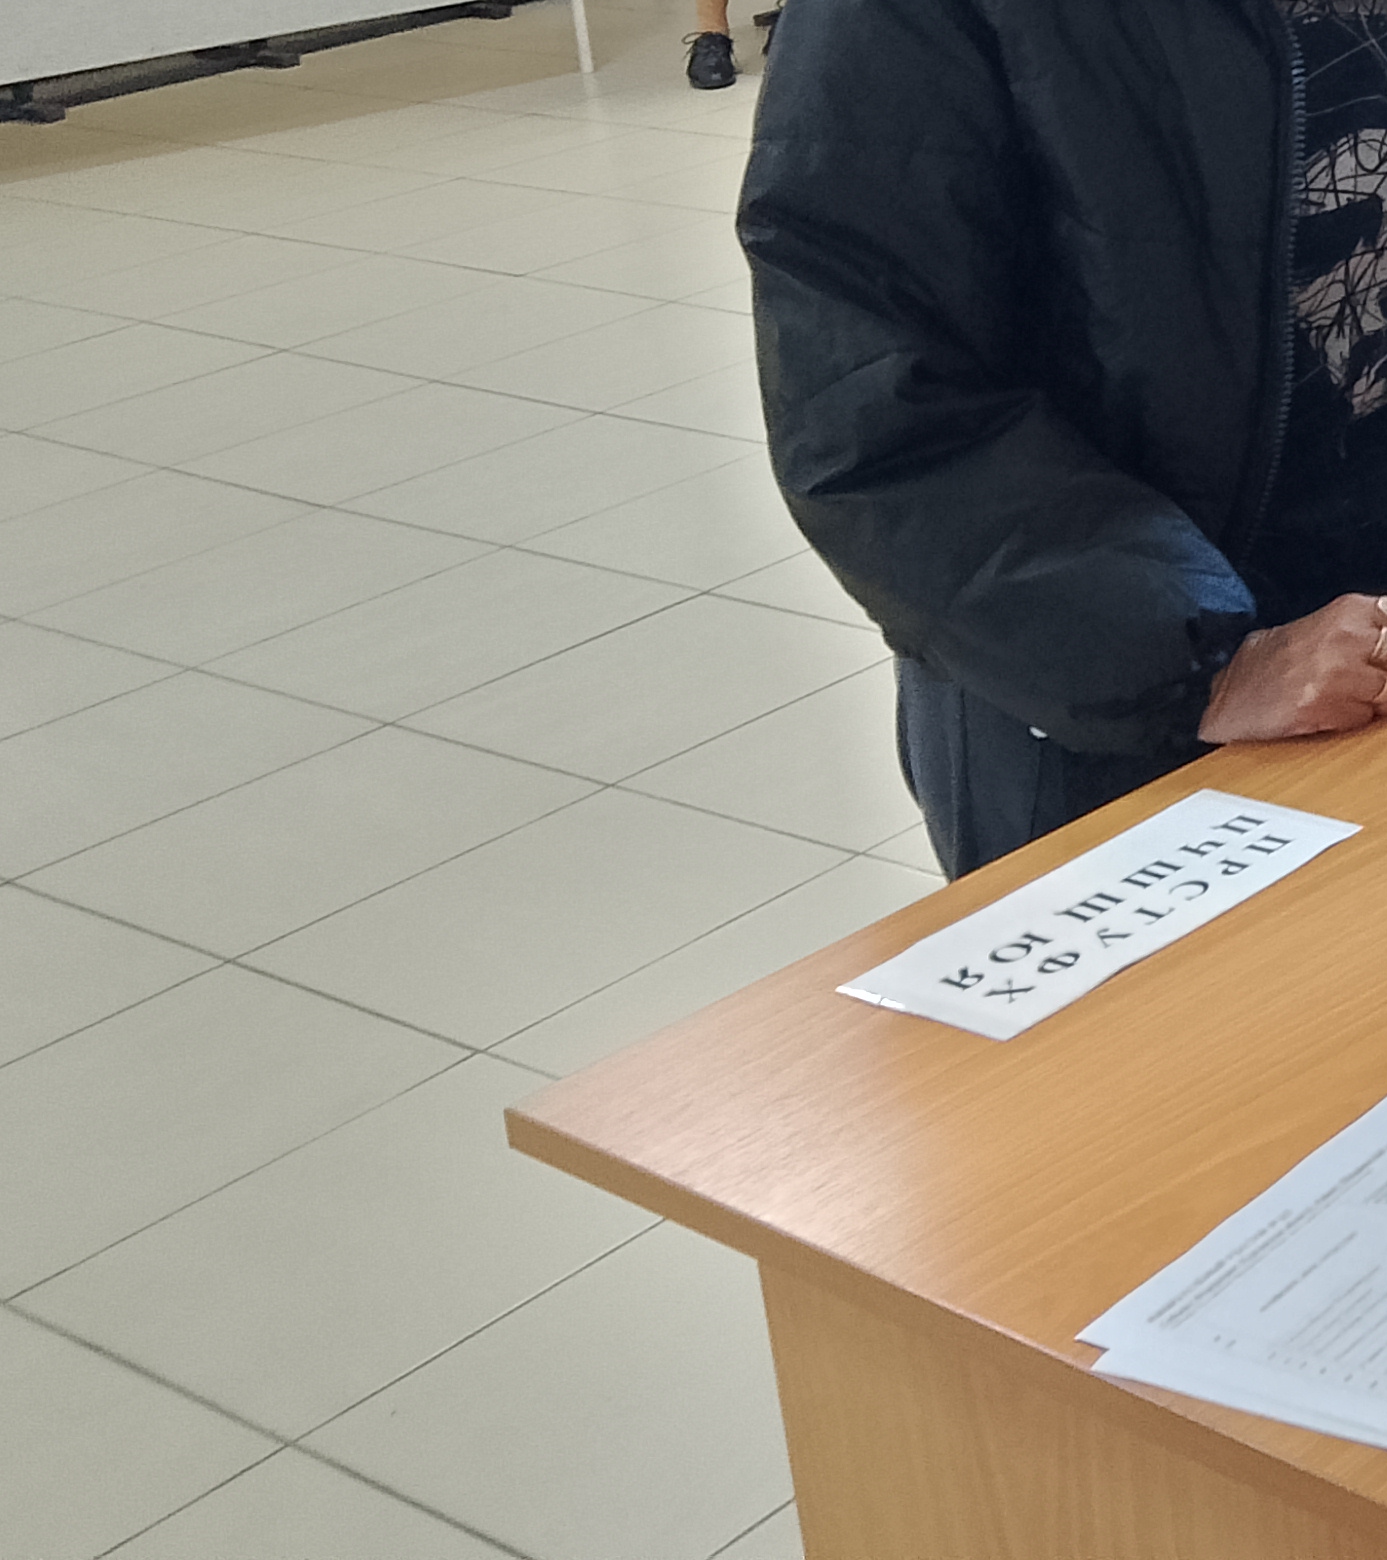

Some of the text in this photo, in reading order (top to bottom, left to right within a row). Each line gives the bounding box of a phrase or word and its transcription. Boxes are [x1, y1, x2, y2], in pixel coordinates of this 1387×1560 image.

[939, 815, 1265, 991] Ц Ч Ш Щ Ю Я
[984, 834, 1293, 1003] П Р С Т У Ф Х
